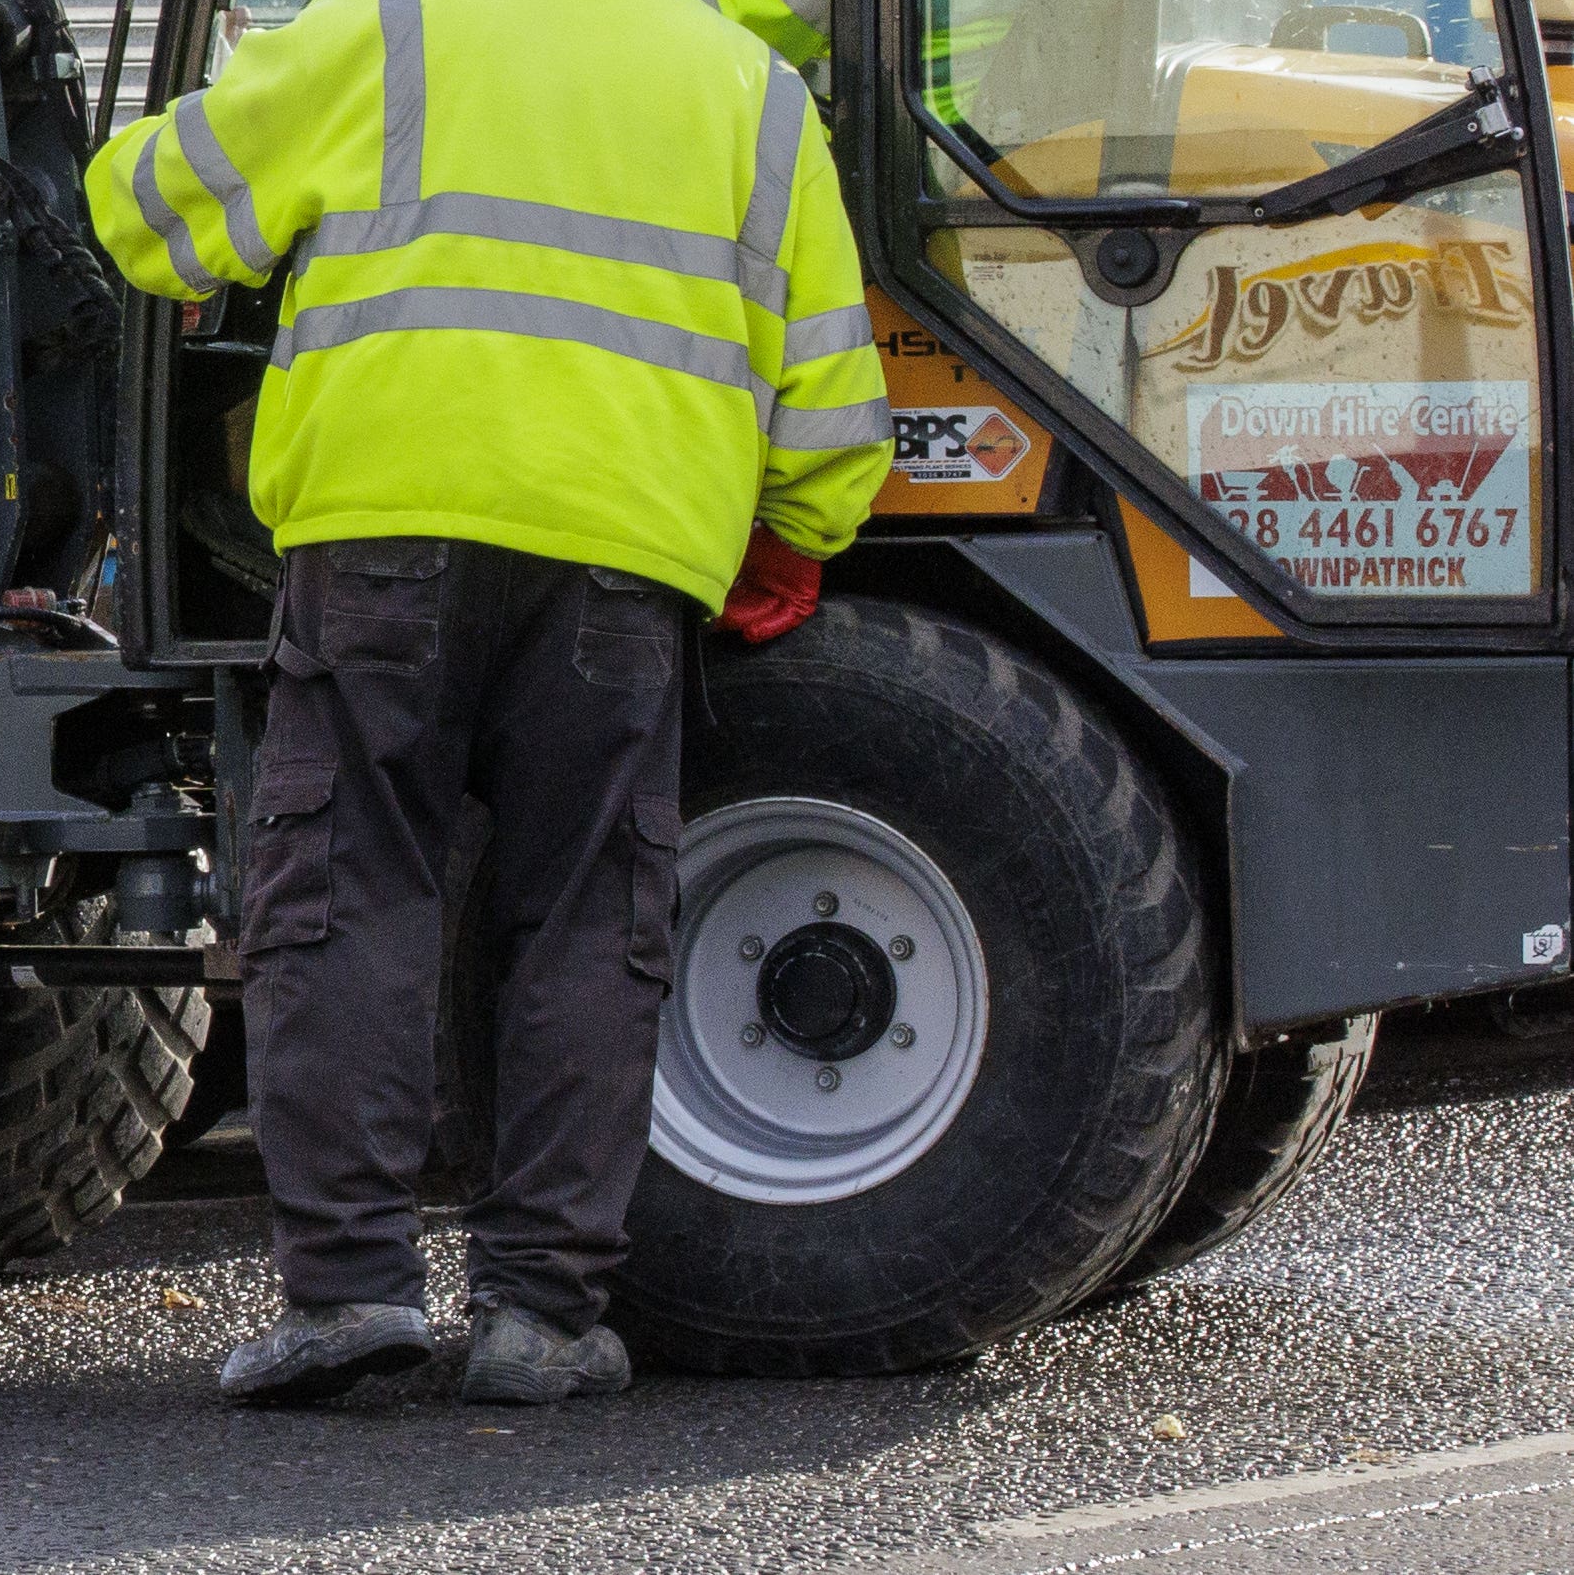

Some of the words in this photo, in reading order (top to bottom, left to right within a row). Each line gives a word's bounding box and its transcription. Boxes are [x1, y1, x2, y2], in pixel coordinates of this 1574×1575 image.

[1221, 396, 1321, 437] Down
[1331, 396, 1399, 437] Hire
[1410, 396, 1518, 437] Centre
[1298, 508, 1393, 548] 4461
[1416, 508, 1518, 548] 6767
[1277, 557, 1467, 587] OWNPATRICK
